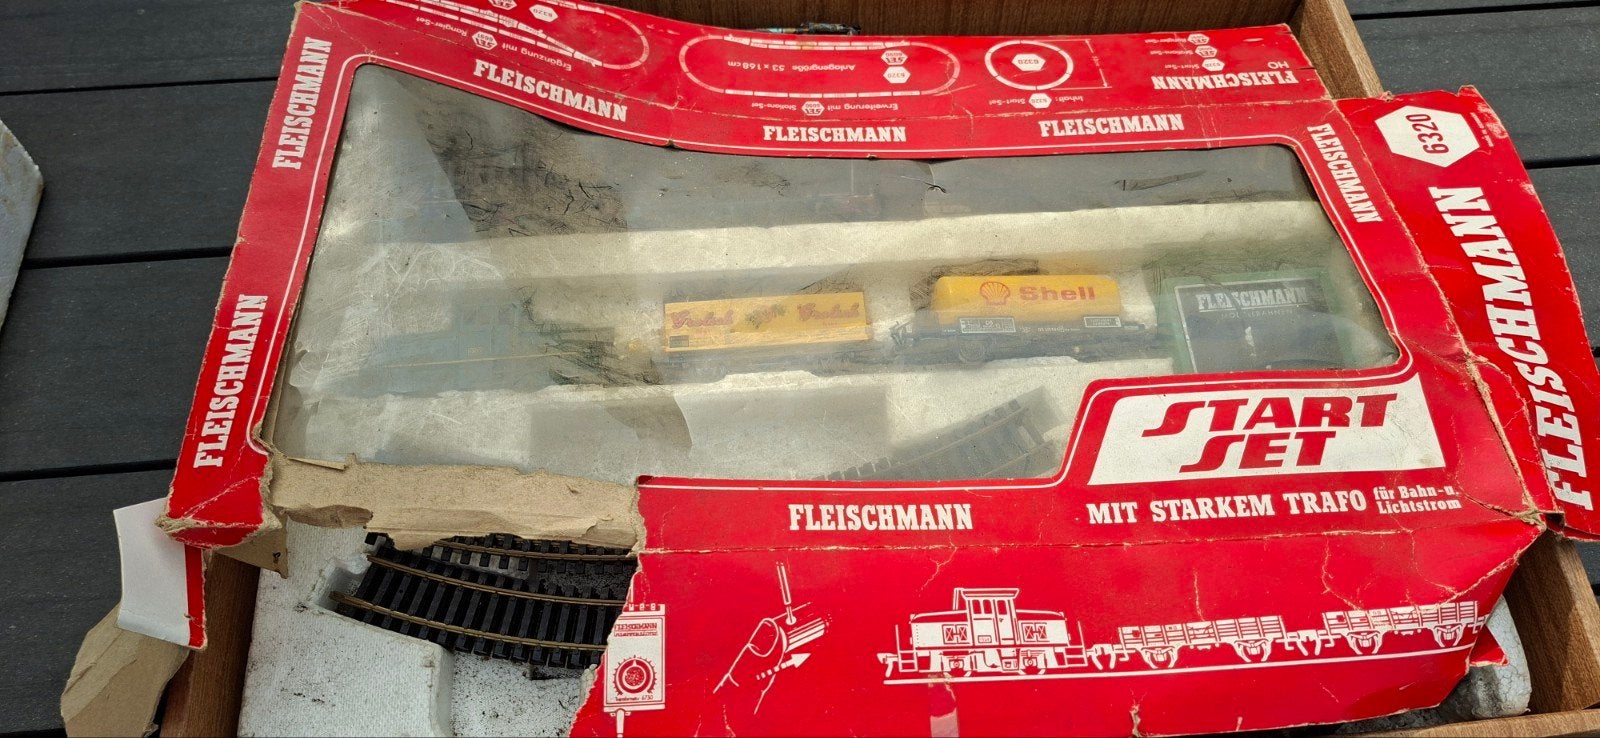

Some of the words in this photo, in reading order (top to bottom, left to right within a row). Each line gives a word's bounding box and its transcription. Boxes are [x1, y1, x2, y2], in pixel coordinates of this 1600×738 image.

[532, 8, 553, 18] 6320
[416, 16, 468, 37] Rangier-Set
[501, 42, 518, 52] mit
[520, 47, 572, 71] Ergänzung
[772, 64, 785, 72] 53
[791, 63, 856, 72] Anlagengröße
[887, 71, 906, 79] 6320
[1151, 70, 1299, 90] FLEISCHMANN
[473, 59, 628, 123] FLEISCHMANN
[272, 37, 333, 170] FLEISCHMANN
[751, 102, 797, 111] Stations-Set
[843, 102, 899, 111] Erweiterung
[988, 98, 1026, 106] Start-Set
[763, 125, 906, 143] FLEISCHMANN
[1038, 114, 1185, 138] FLEISCHMANN
[1405, 113, 1450, 154] 6320
[1307, 123, 1383, 224] FLEISCHMANN
[1018, 286, 1096, 301] Shell
[1428, 186, 1593, 512] FLEISCHMANN
[193, 294, 269, 468] FLEISCHMANN
[1141, 393, 1398, 438] START
[1179, 430, 1337, 474] SET
[1086, 502, 1138, 524] MIT
[1151, 493, 1276, 522] STARKEM
[1283, 489, 1367, 515] TRAFO
[1373, 486, 1395, 500] für
[1376, 499, 1462, 514] Lichtstrom
[788, 503, 973, 531] FLEISCHMANN
